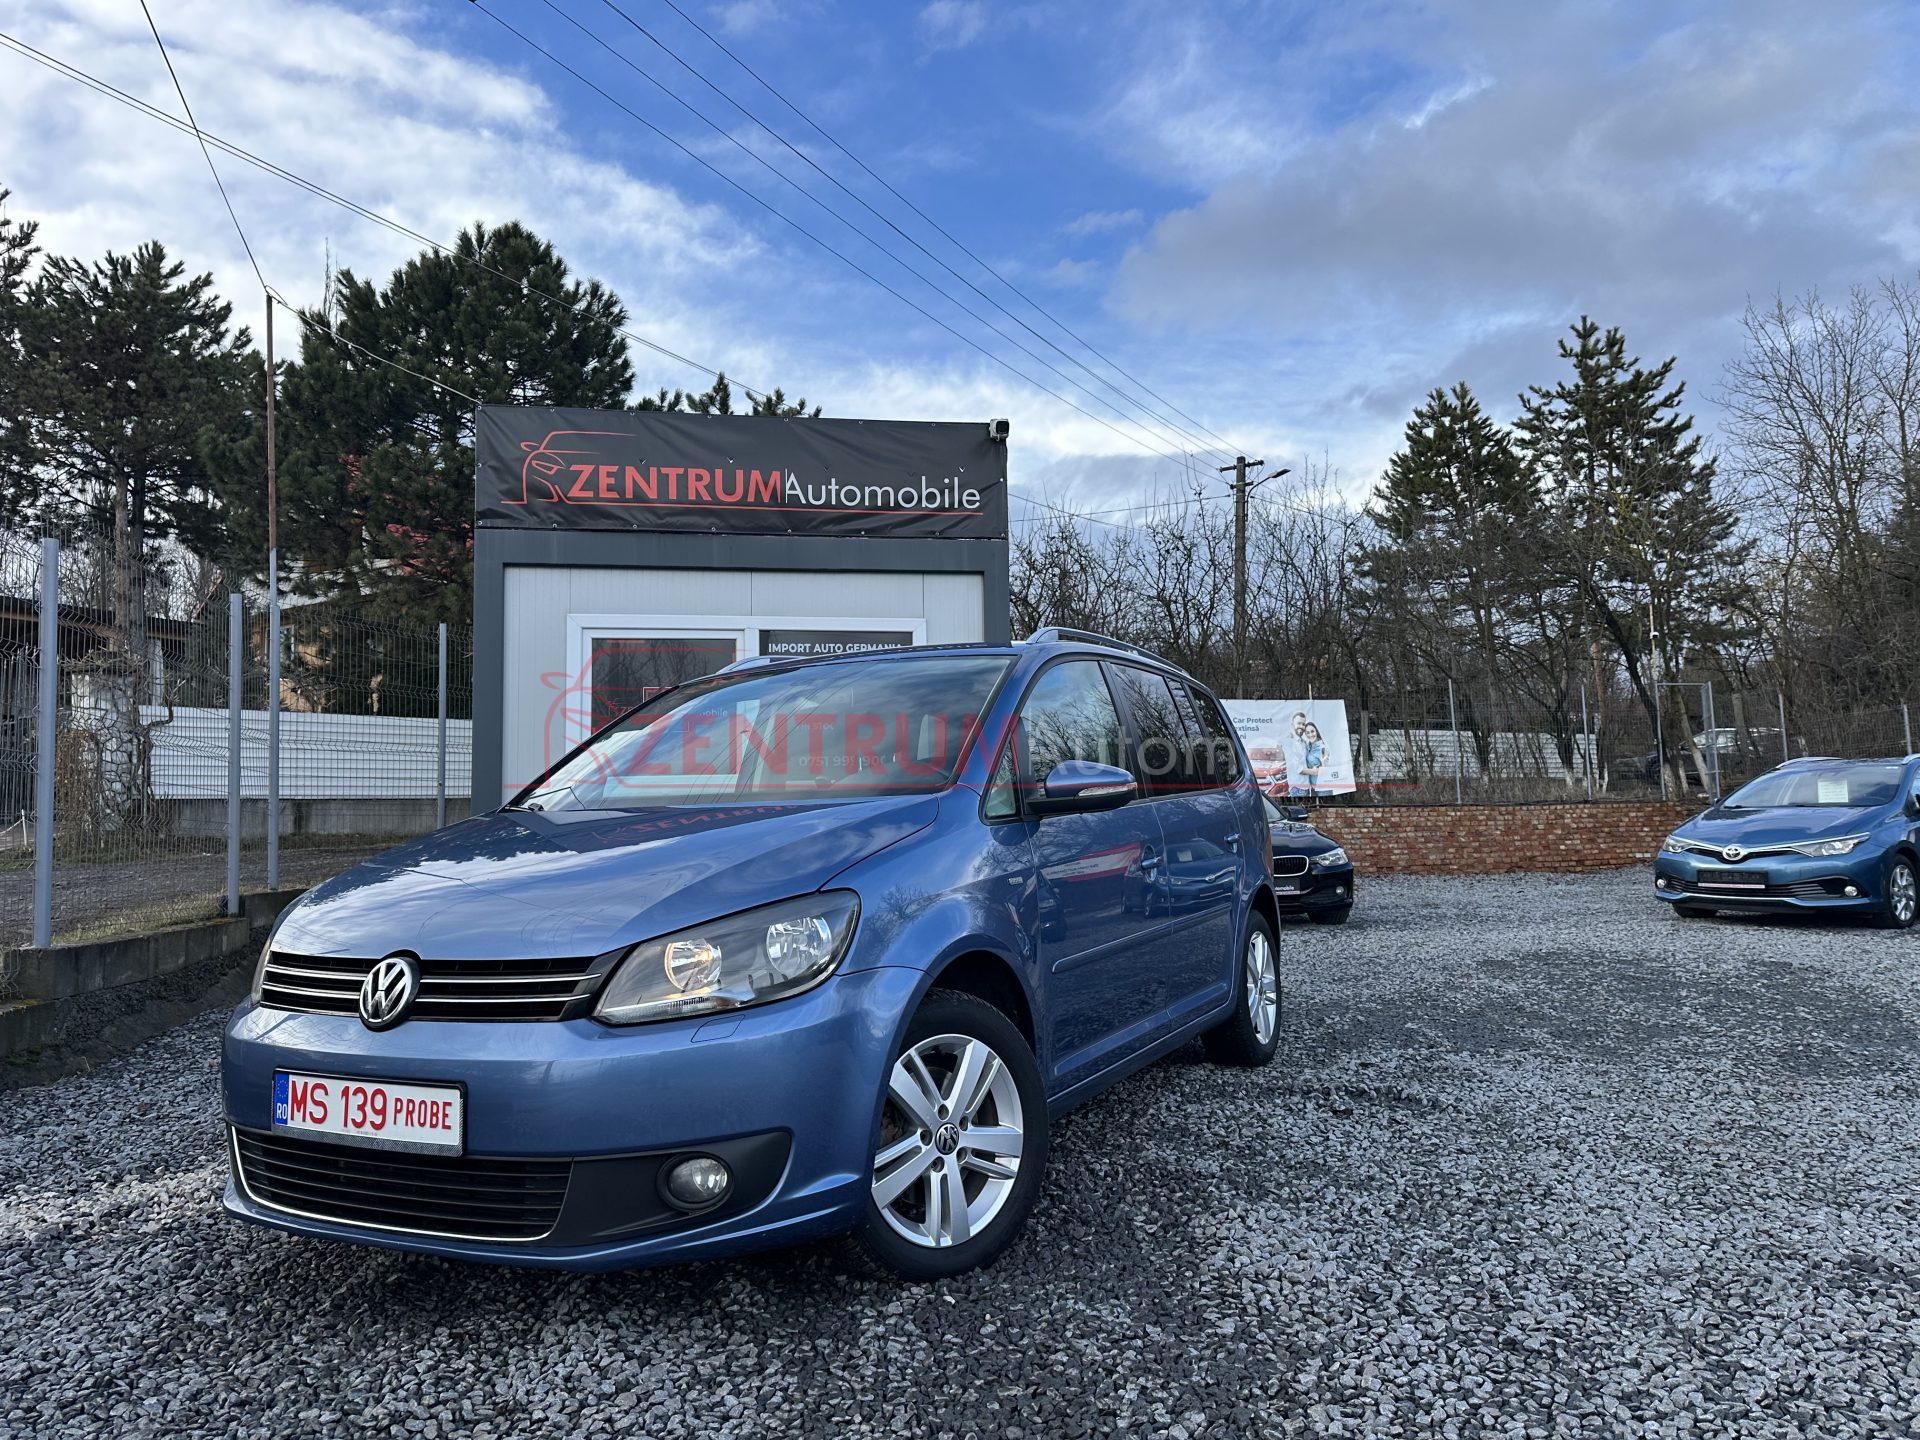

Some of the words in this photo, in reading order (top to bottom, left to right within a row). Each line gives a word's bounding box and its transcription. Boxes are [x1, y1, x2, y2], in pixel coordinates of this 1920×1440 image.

[567, 464, 782, 504] ZENTRUM
[786, 471, 981, 509] Automobile
[768, 643, 809, 653] IMPORT
[813, 643, 844, 653] AUTO
[276, 1102, 288, 1120] RO
[290, 1080, 329, 1125] MS
[341, 1085, 388, 1131] 139
[393, 1097, 453, 1130] PROBE
